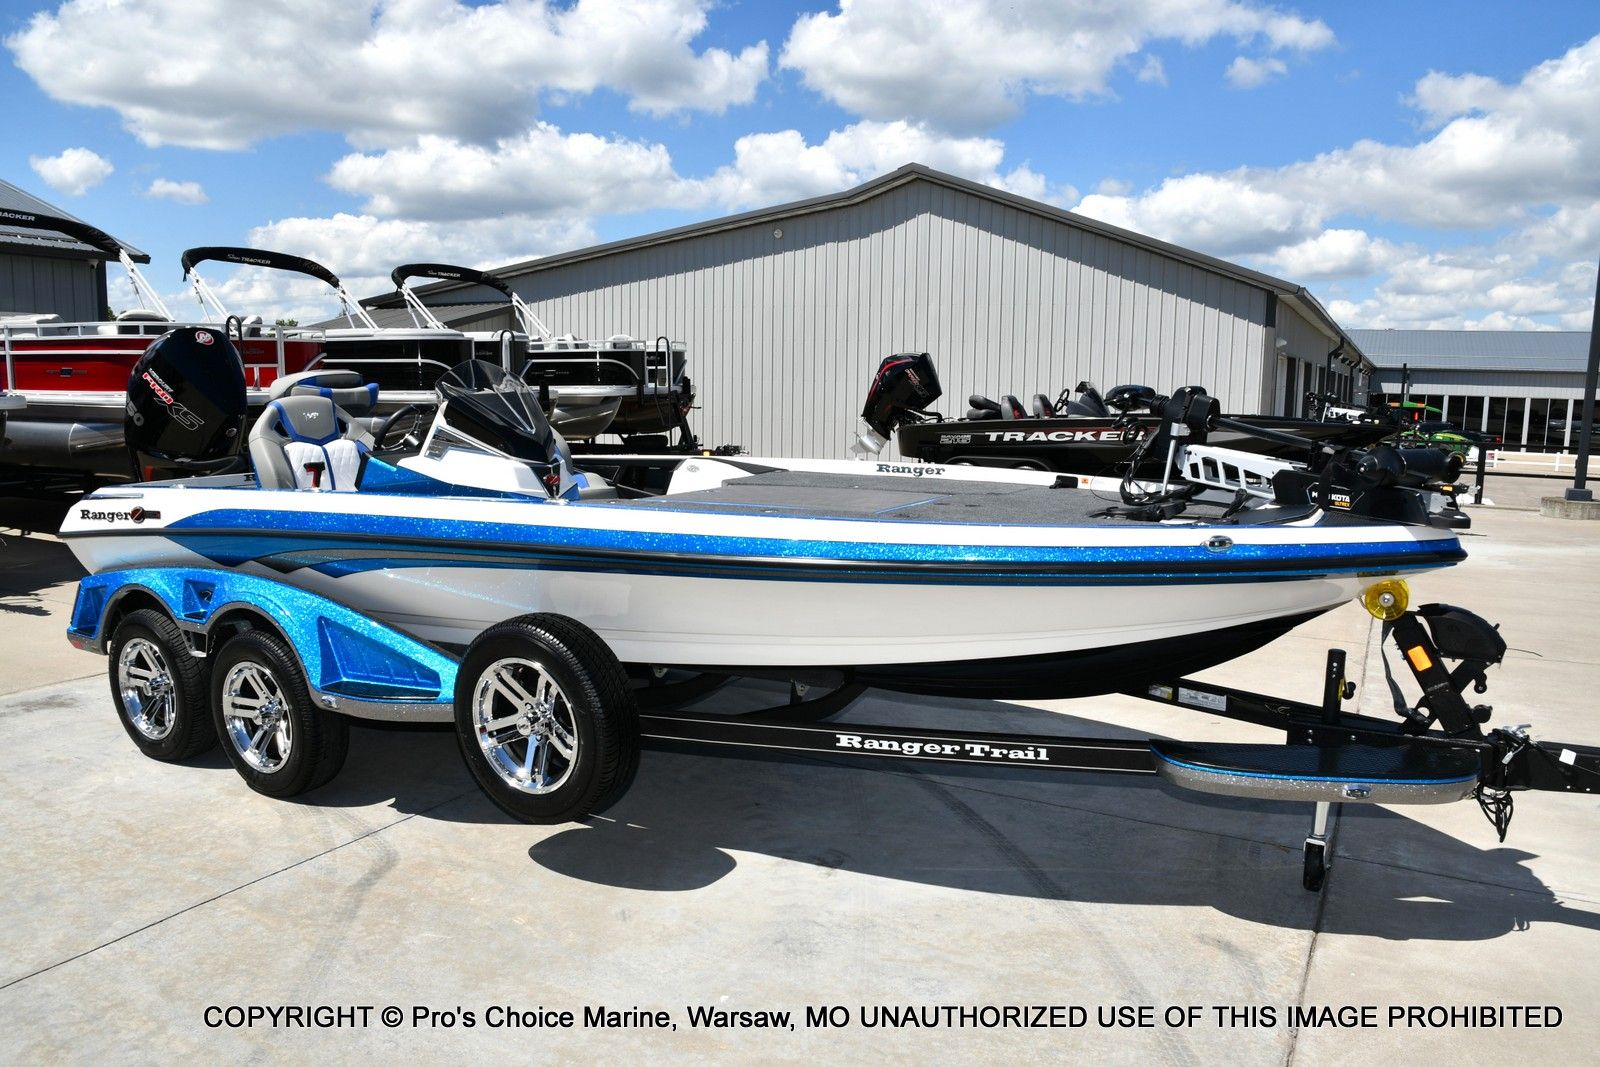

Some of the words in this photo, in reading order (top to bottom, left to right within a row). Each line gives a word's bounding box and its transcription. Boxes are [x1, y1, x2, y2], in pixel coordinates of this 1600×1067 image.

[241, 256, 271, 265] TRACKER
[876, 463, 946, 477] Ranger
[1331, 494, 1350, 502] KOTA
[80, 509, 130, 523] Ranger
[835, 734, 961, 755] Ranger
[965, 743, 1050, 761] Trail
